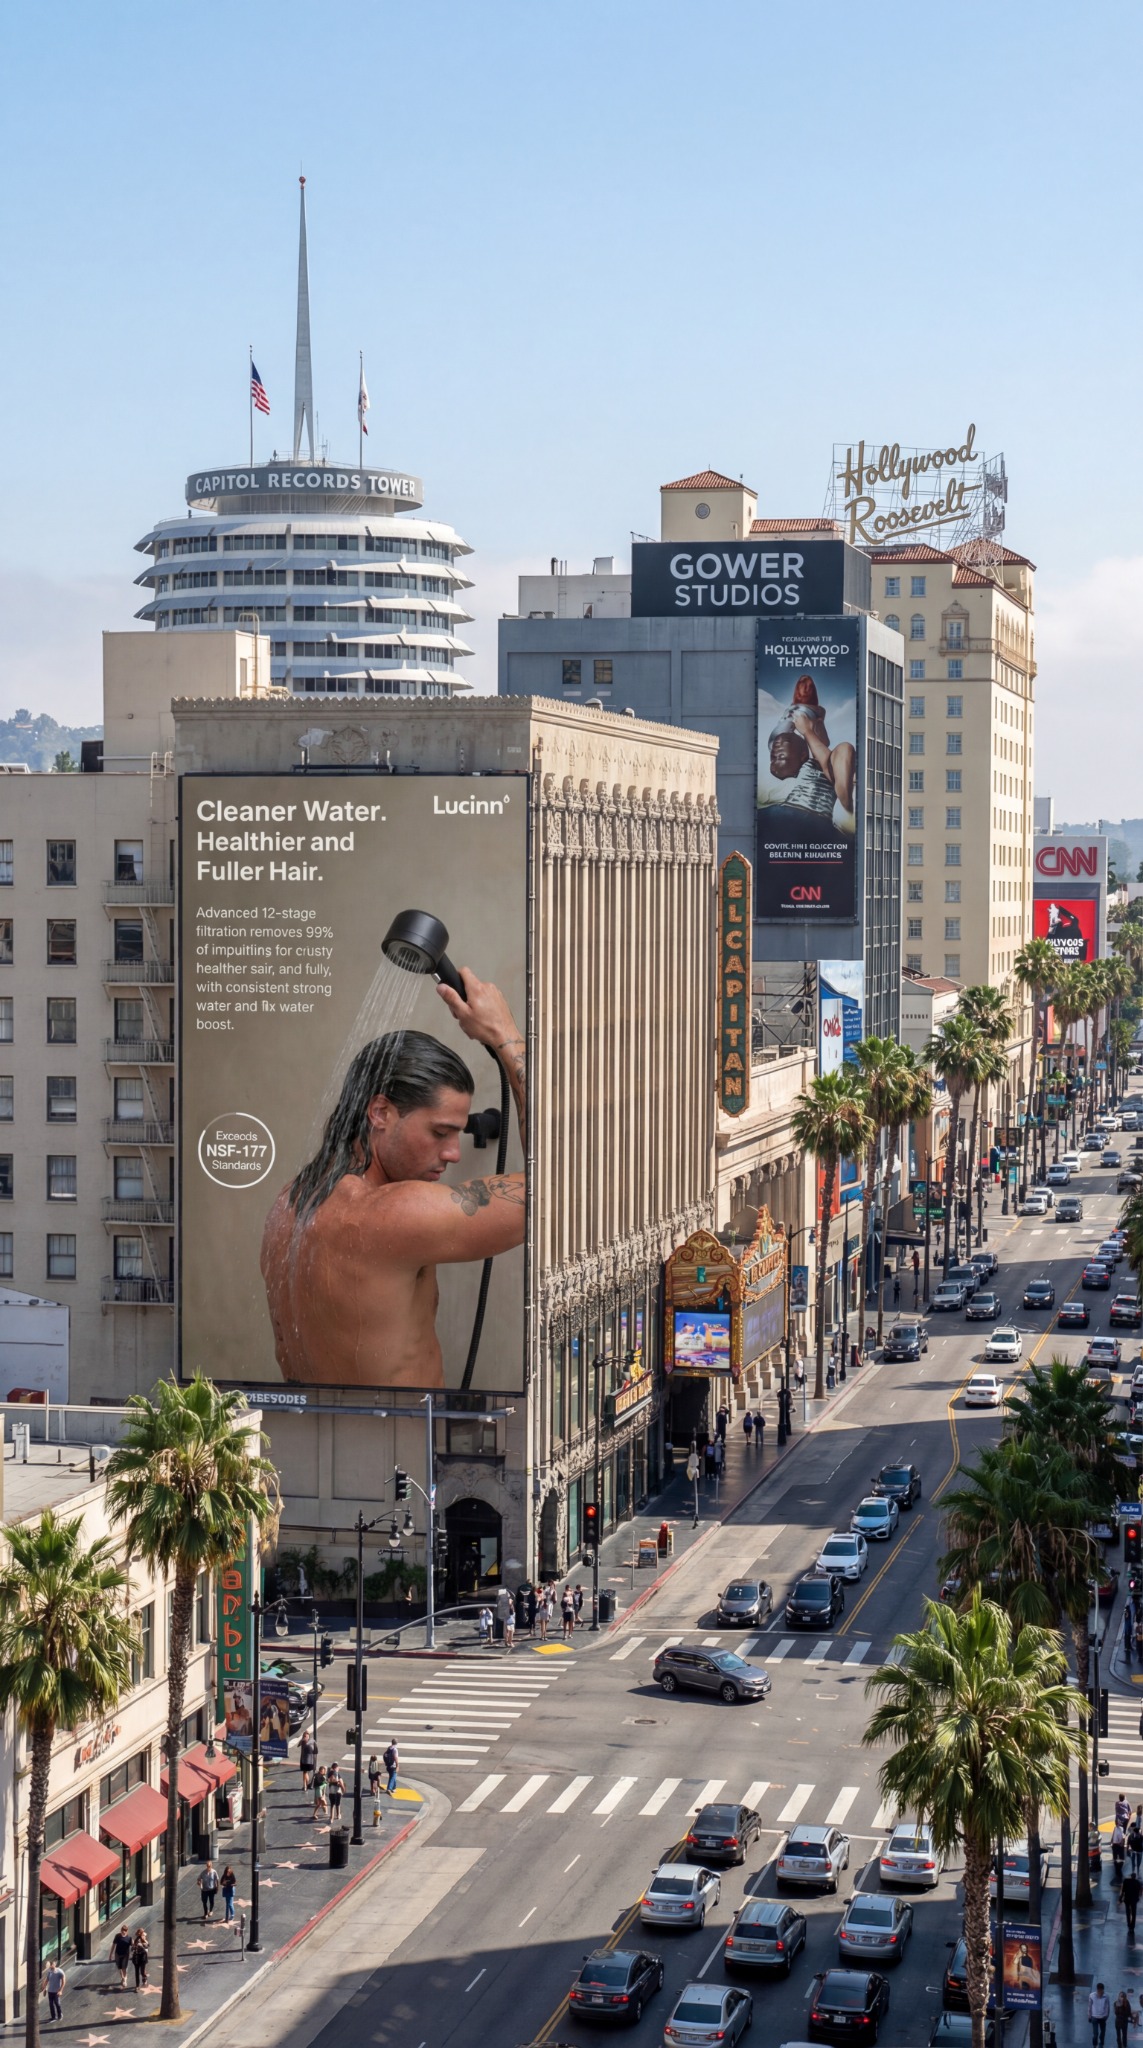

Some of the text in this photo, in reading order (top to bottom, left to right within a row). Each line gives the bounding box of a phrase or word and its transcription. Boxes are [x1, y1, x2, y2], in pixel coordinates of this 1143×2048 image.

[836, 423, 979, 500] Hollywood
[195, 472, 416, 497] CAPITOL RECORDS TOWER
[844, 478, 983, 545] Roosevelt
[670, 553, 804, 579] GOWER
[675, 584, 800, 606] STUDIOS
[765, 645, 849, 655] HOLLYWOOD
[777, 657, 836, 667] THEATRE
[196, 800, 387, 822] Cleaner Water.
[433, 794, 503, 814] Lucinn
[197, 831, 355, 851] Healthier and
[1035, 847, 1098, 876] CNN
[197, 861, 324, 881] Fuller Hair.
[790, 886, 822, 901] CNN
[196, 907, 317, 921] Advanced 12-stage
[196, 926, 334, 938] filtration removes 99%
[196, 944, 209, 956] of
[275, 944, 293, 956] for
[196, 962, 247, 974] healther
[279, 963, 302, 975] and
[305, 963, 332, 978] fully,
[196, 981, 332, 997] with consistent strong
[196, 1001, 231, 1012] water
[234, 1001, 258, 1012] and
[279, 1002, 315, 1013] water
[196, 1018, 235, 1030] boost.
[206, 1144, 267, 1158] NSF-177
